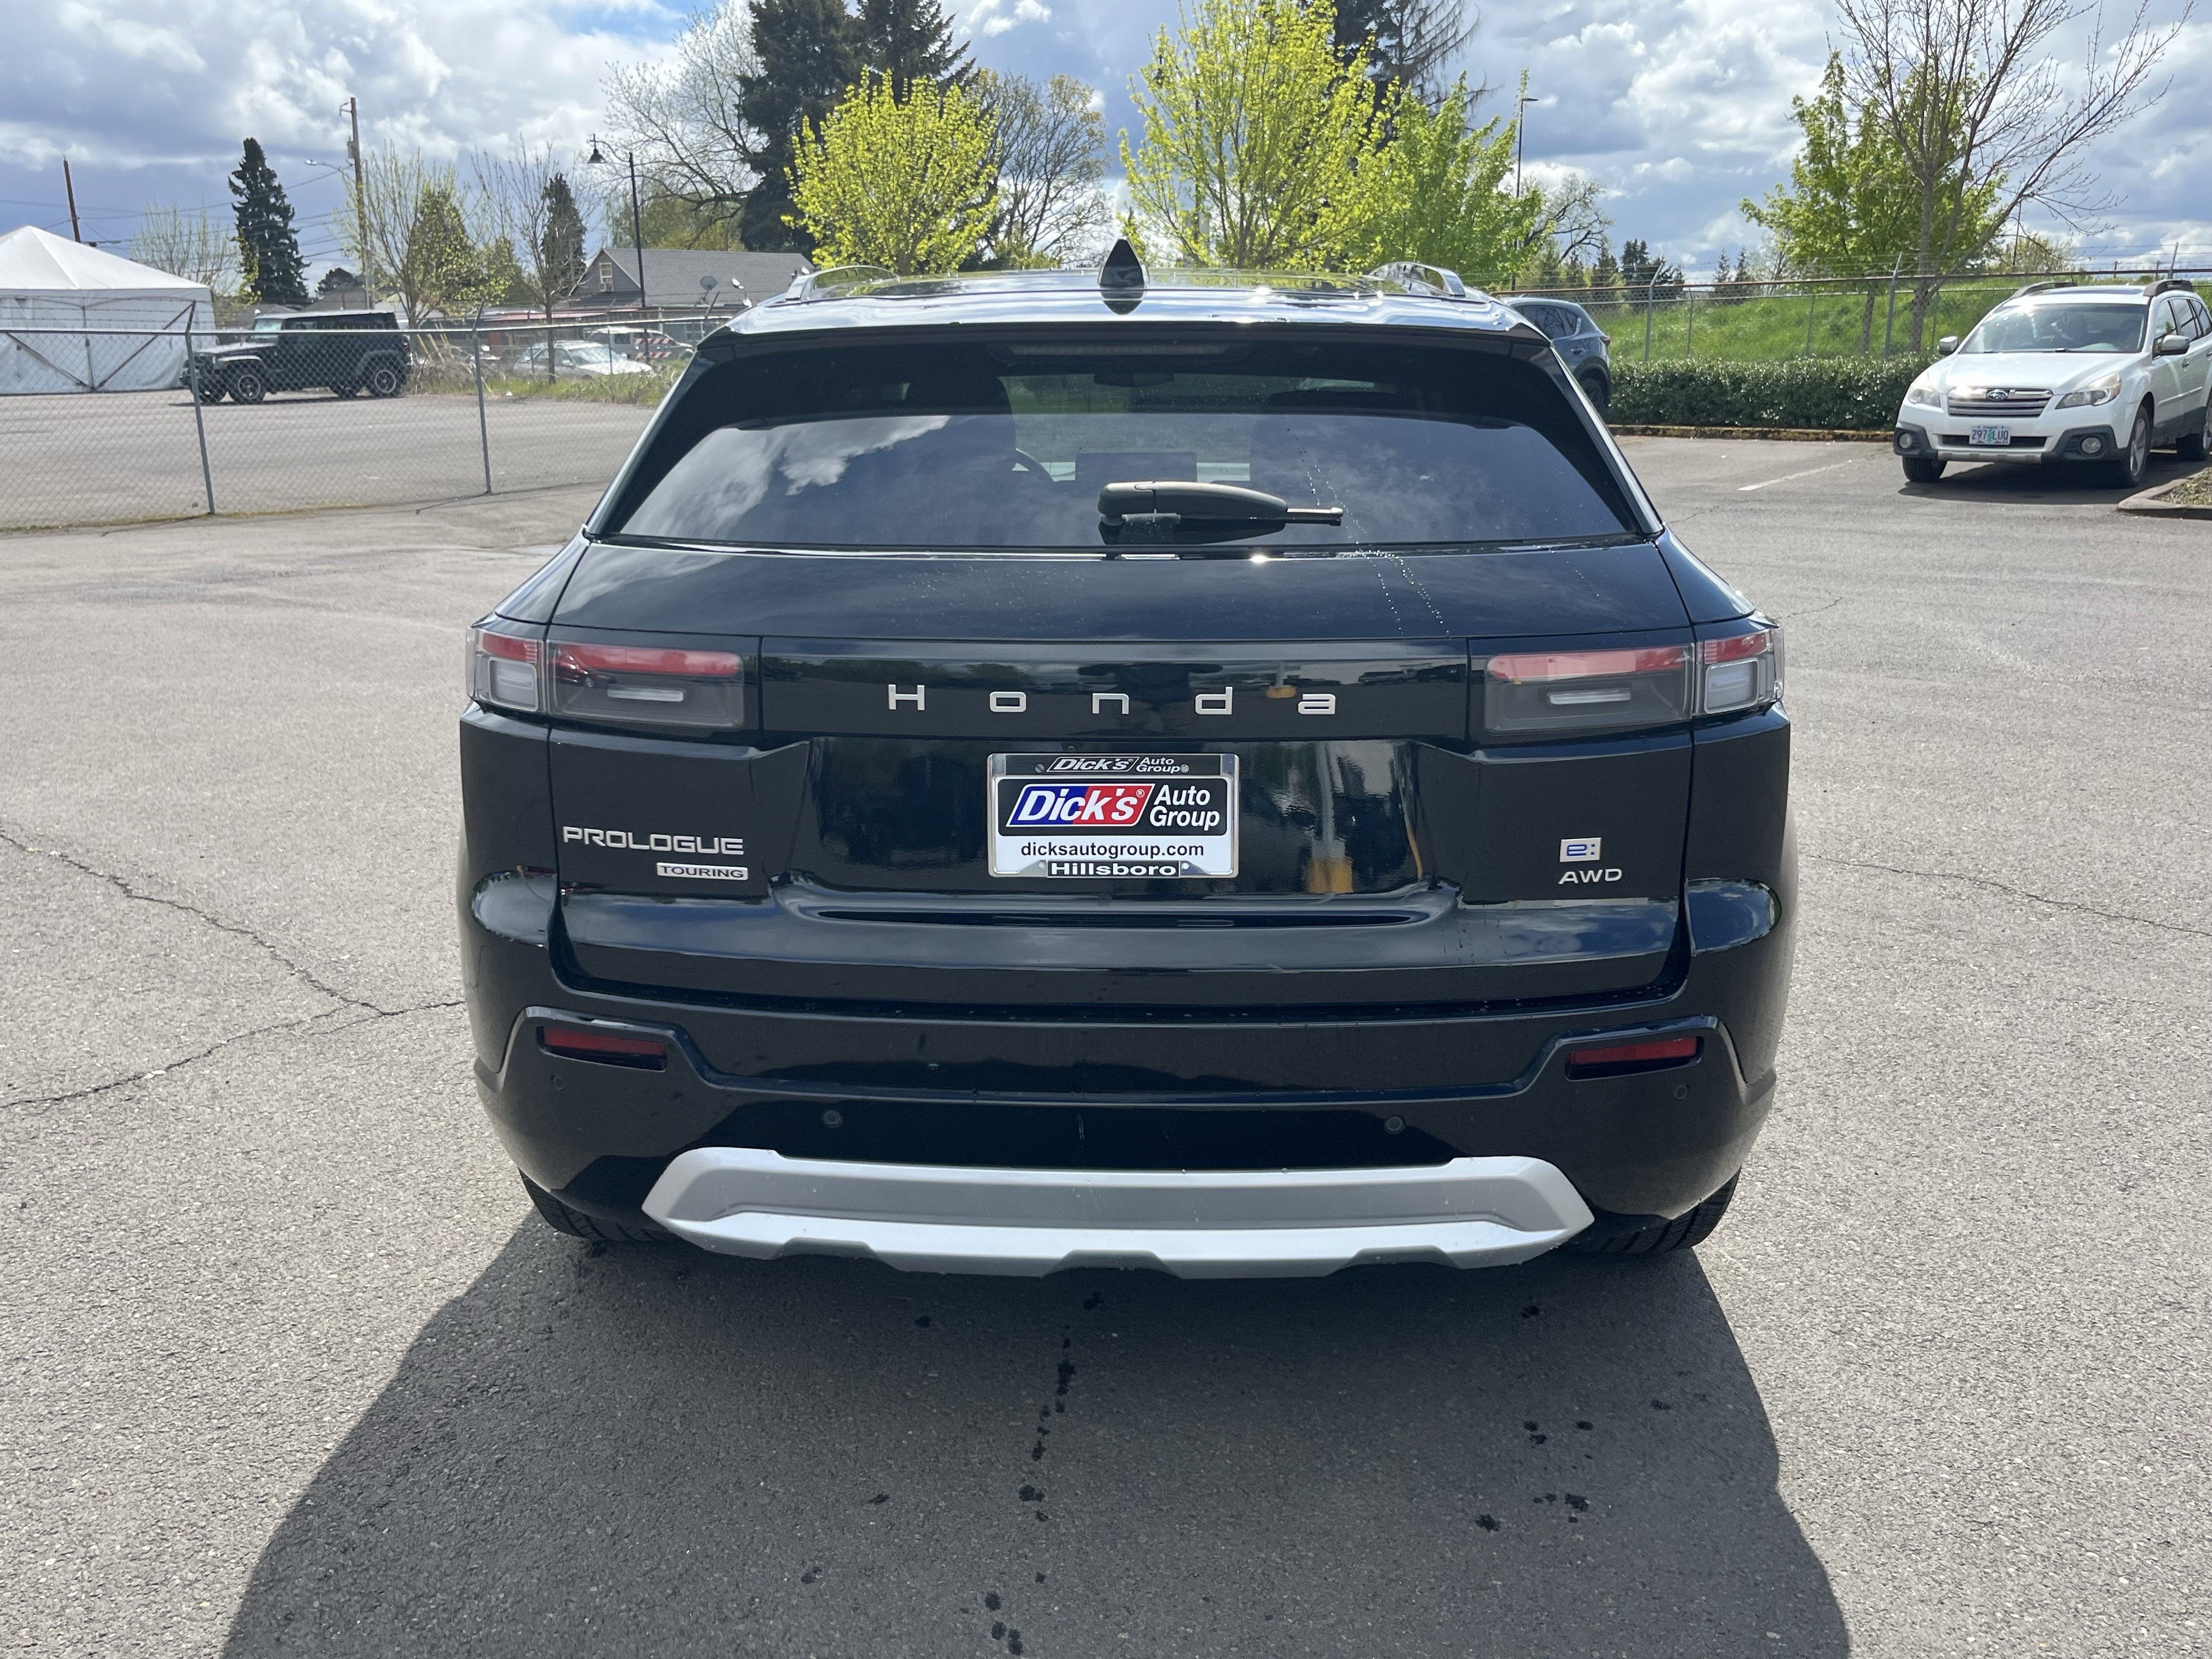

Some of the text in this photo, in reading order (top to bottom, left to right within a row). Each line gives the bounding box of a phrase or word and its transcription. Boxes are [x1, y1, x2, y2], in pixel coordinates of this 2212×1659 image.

[887, 684, 1336, 715] Honda
[1136, 764, 1180, 774] Group
[1153, 785, 1210, 805] Auto
[1149, 805, 1220, 831] Group
[562, 826, 744, 855] PROLOGUE
[1021, 842, 1204, 859] dicksautogroup.com
[661, 865, 744, 878] TOURING
[1051, 862, 1176, 876] Hillsboro
[1558, 868, 1622, 884] AWD
